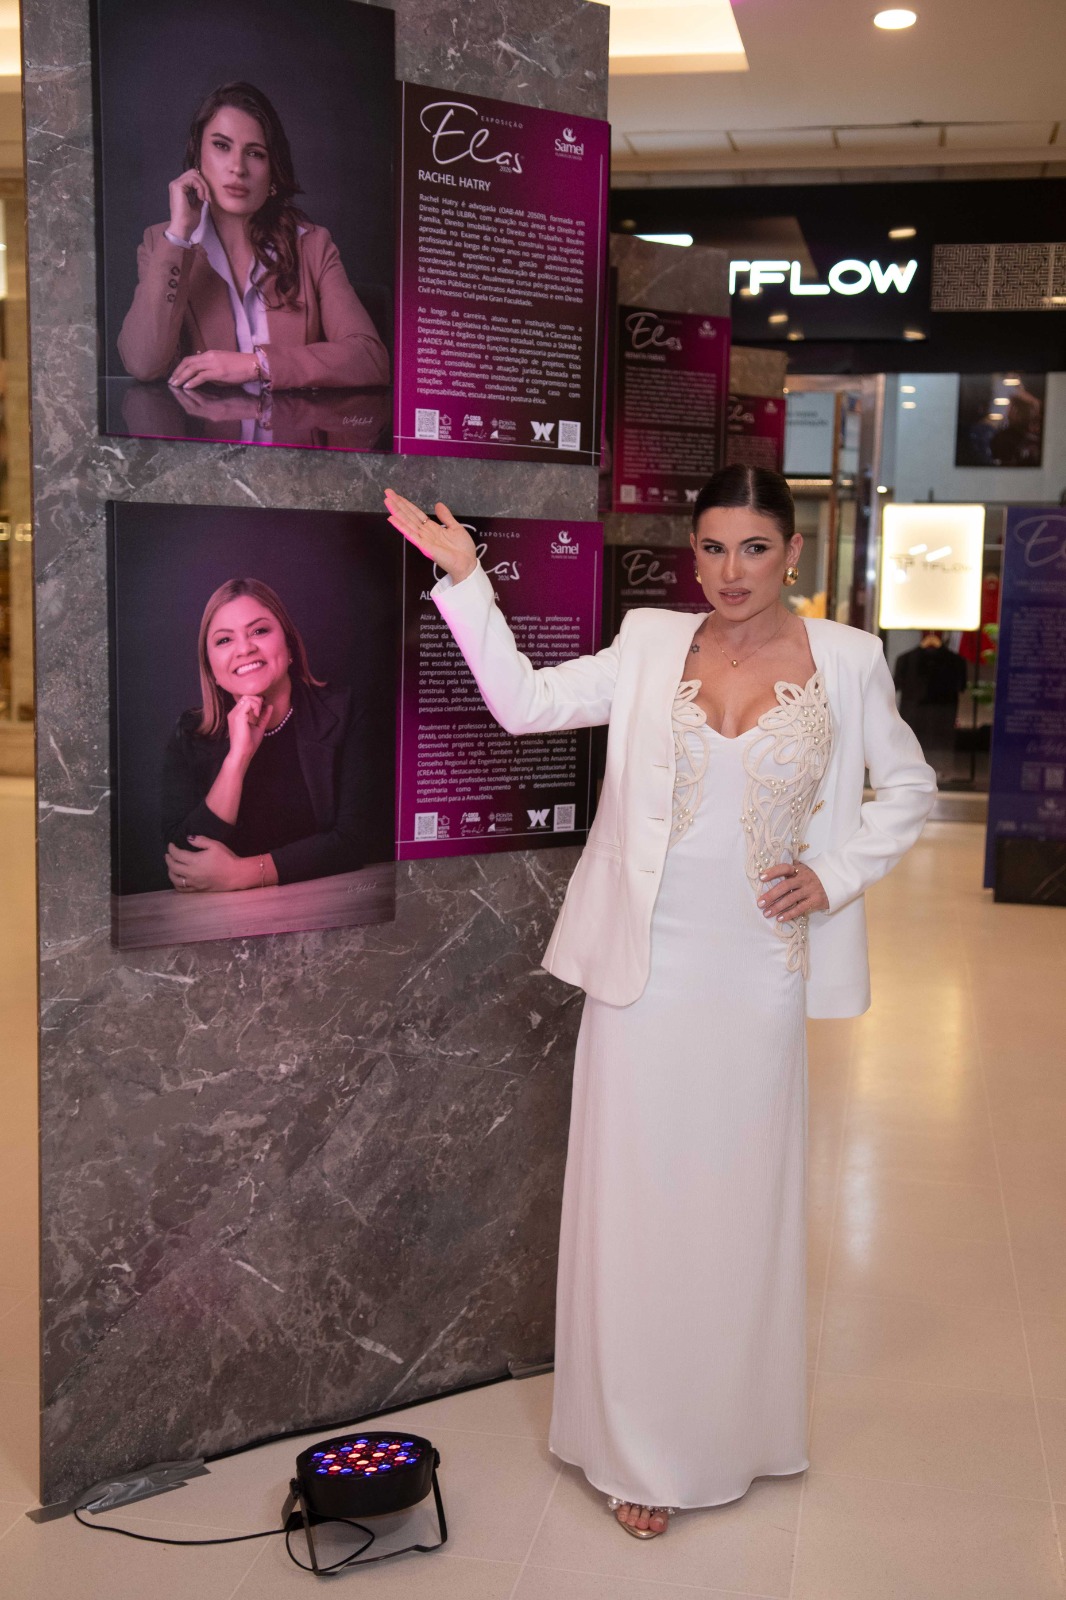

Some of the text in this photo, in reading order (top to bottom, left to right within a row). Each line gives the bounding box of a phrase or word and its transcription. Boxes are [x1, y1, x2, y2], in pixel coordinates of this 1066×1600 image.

[480, 114, 524, 128] EXPOSIÇÃO
[420, 101, 523, 174] Elas
[554, 138, 584, 156] Samel
[418, 170, 491, 191] RACHEL HATRY
[419, 194, 440, 204] Rachel
[442, 198, 459, 209] Hatry
[468, 202, 497, 215] advogada
[550, 215, 574, 225] formada
[418, 245, 456, 257] desenvolveu
[462, 251, 496, 264] experiência
[519, 259, 538, 270] gestão
[418, 285, 431, 294] Civil
[436, 288, 463, 298] Processo
[463, 291, 476, 299] Civil
[475, 293, 488, 302] pela
[489, 294, 503, 303] Gran
[430, 307, 448, 317] longo
[525, 319, 556, 330] instituições
[417, 346, 438, 356] gestão
[441, 349, 482, 359] administrativa
[492, 354, 528, 366] coordenação
[417, 356, 441, 365] vivência
[444, 359, 476, 369] consolidou
[496, 364, 519, 374] atuação
[522, 367, 543, 377] jurídica
[546, 369, 569, 378] baseada
[417, 376, 443, 387] soluções
[485, 383, 518, 392] conduzindo
[550, 542, 579, 554] Samel
[545, 615, 573, 623] professora
[419, 669, 457, 677] compromisso
[446, 678, 459, 686] pela
[418, 705, 444, 714] pesquisa
[458, 722, 487, 731] professora
[452, 741, 475, 749] projetos
[487, 739, 511, 748] pesquisa
[522, 747, 550, 755] presidente
[444, 759, 468, 767] Regional
[477, 757, 507, 766] Engenharia
[513, 756, 542, 765] Agronomia
[510, 764, 534, 773] liderança
[417, 786, 448, 795] engenharia
[533, 780, 576, 788] desenvolvimento
